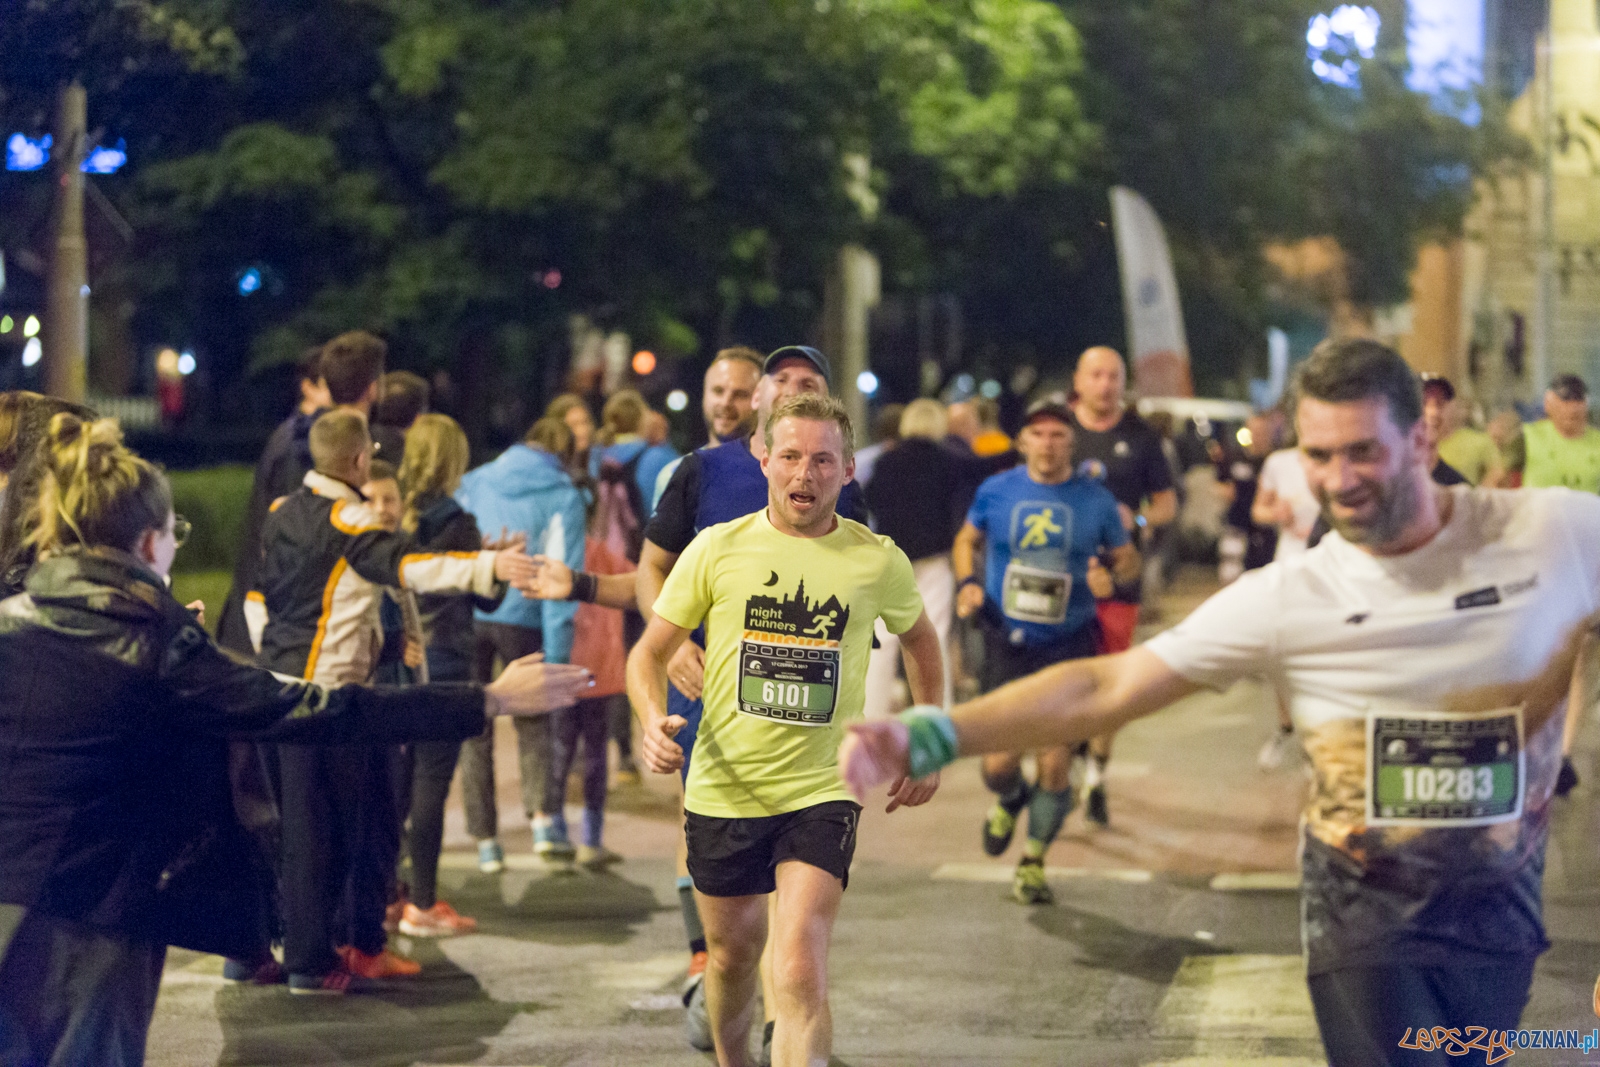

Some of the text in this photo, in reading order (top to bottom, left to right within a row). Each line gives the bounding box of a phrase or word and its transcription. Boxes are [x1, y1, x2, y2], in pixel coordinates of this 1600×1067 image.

[750, 606, 783, 619] night
[749, 618, 797, 632] runners
[762, 681, 810, 708] 6101
[1402, 766, 1494, 801] 10283
